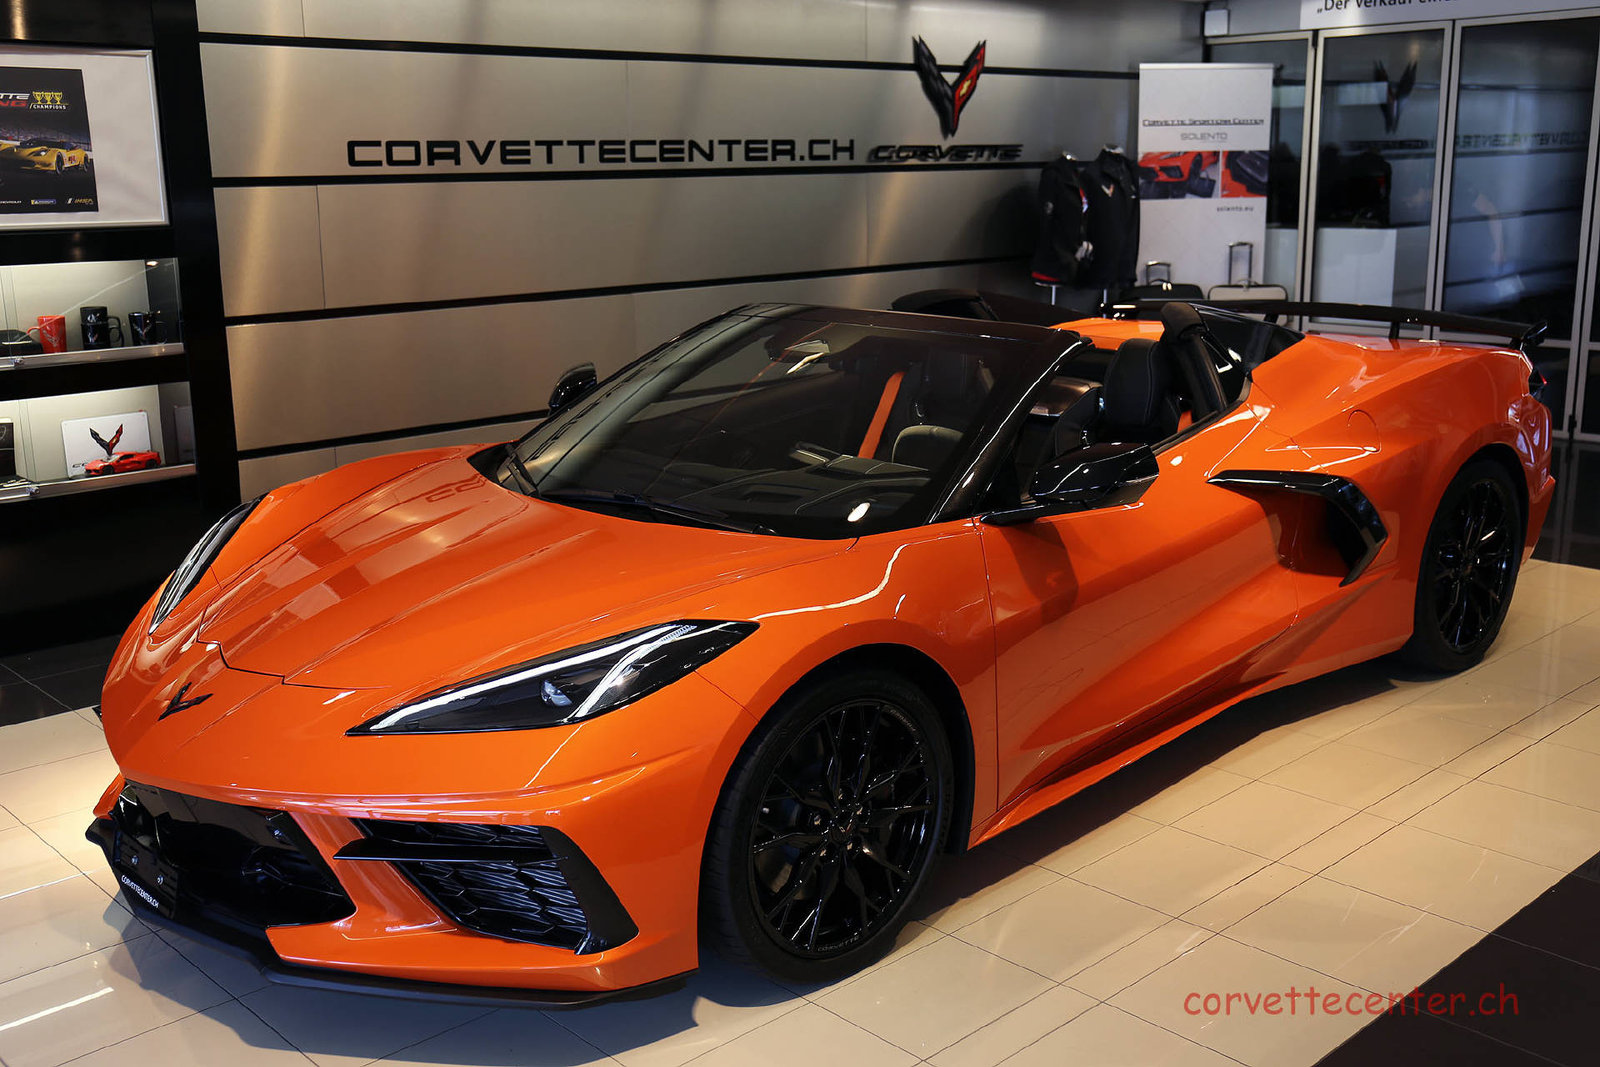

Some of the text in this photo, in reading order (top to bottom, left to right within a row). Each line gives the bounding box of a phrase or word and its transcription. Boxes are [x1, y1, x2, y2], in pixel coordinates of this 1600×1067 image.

[1180, 132, 1228, 141] SOLENTO
[347, 139, 854, 167] CORVETTECENTER.CH
[869, 144, 1023, 162] CORVETTE
